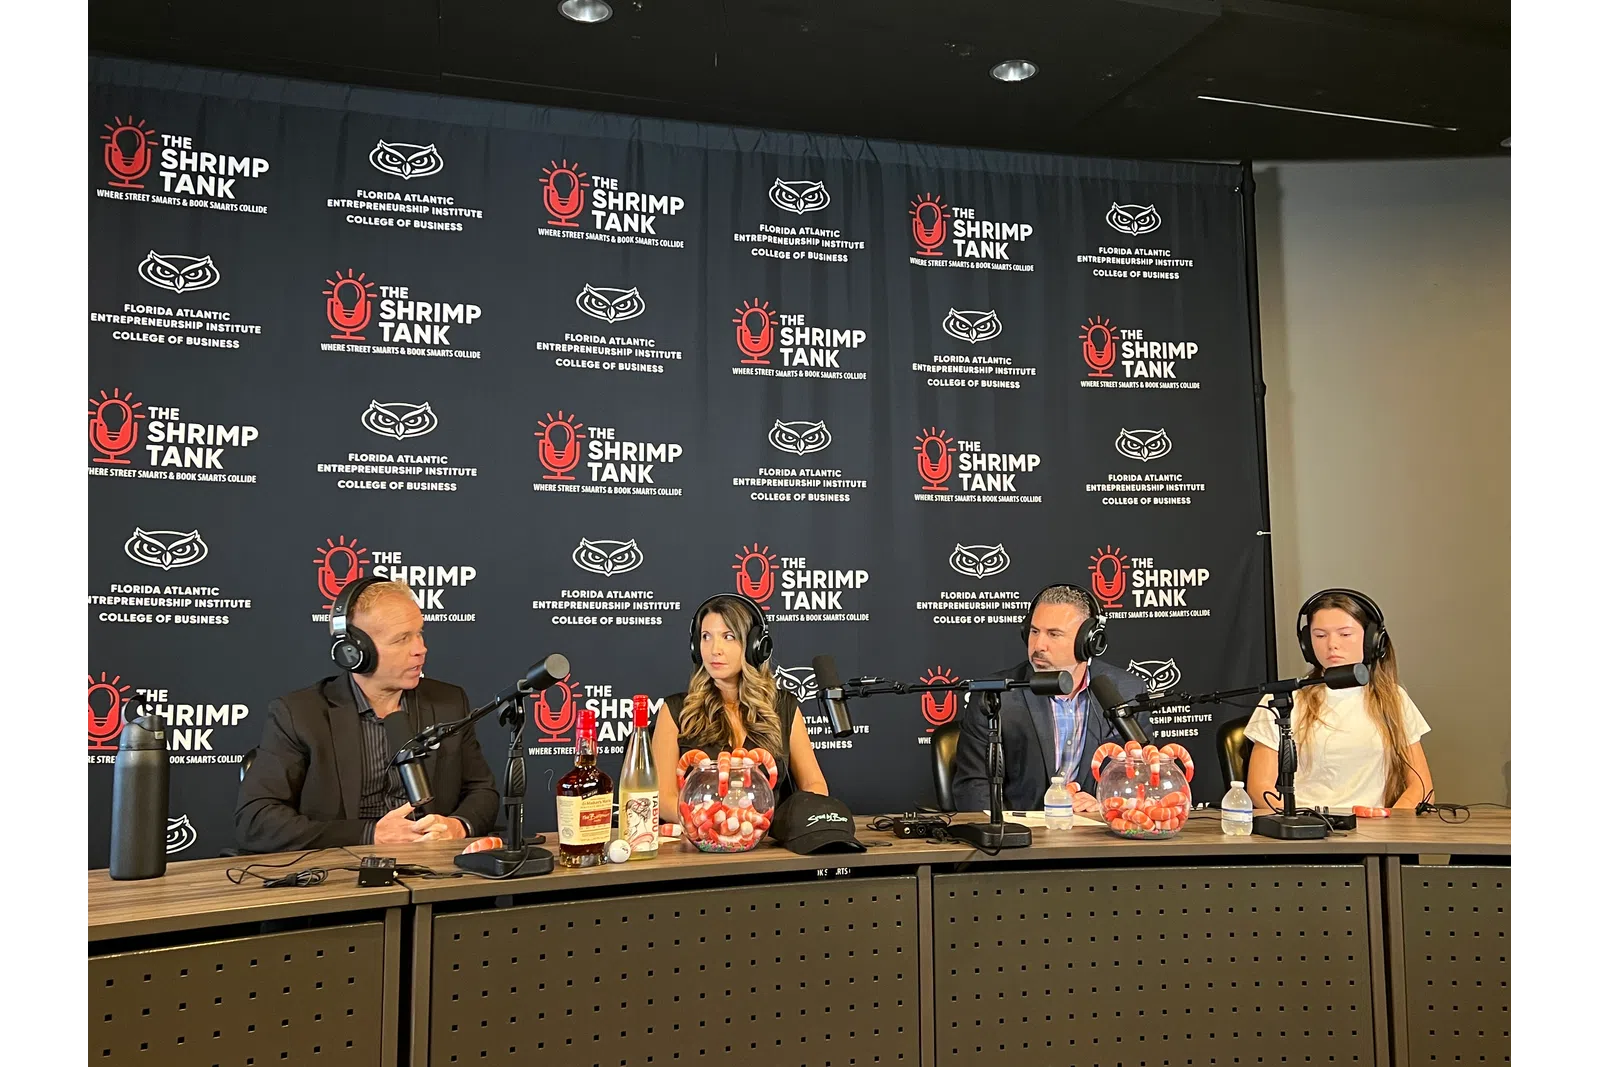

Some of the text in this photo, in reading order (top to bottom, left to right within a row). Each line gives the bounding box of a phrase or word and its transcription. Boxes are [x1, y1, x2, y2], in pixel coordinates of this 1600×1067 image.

[161, 134, 192, 149] THE
[161, 149, 269, 178] SHRIMP
[160, 171, 235, 199] TANK
[592, 176, 618, 190] THE
[97, 189, 123, 200] WHERE
[125, 193, 150, 201] STREET
[152, 195, 180, 205] SMARTS
[189, 200, 208, 208] BOOK
[210, 202, 238, 211] SMARTS
[239, 204, 267, 214] COLLIDE
[357, 190, 454, 205] FLORIDA ATLANTIC
[592, 189, 684, 215] SHRIMP
[328, 199, 482, 218] ENTREPRENEURSHIP INSTITUTE
[952, 208, 974, 220] THE
[346, 215, 462, 231] COLLEGE OF BUSINESS
[592, 210, 656, 234] TANK
[760, 224, 840, 237] FLORIDA ATLANTIC
[954, 219, 1032, 241] SHRIMP
[734, 234, 864, 249] ENTREPRENEURSHIP INSTITUTE
[752, 248, 790, 259] COLLEGE
[808, 252, 848, 262] BUSINESS
[953, 239, 1009, 260] TANK
[1134, 248, 1170, 256] ATLANTIC
[1077, 256, 1153, 265] ENTREPRENEURSHIP
[1093, 269, 1127, 277] COLLEGE
[380, 286, 408, 298] THE
[124, 304, 230, 320] FLORIDA ATLANTIC
[380, 300, 481, 324] SHRIMP
[90, 313, 261, 334] ENTREPRENEURSHIP INSTITUTE
[780, 315, 804, 326] THE
[113, 331, 239, 348] COLLEGE OF BUSINESS
[379, 322, 450, 345] TANK
[565, 334, 655, 347] FLORIDA ATLANTIC
[780, 327, 866, 348] SHRIMP
[1121, 330, 1143, 340] THE
[537, 342, 681, 359] ENTREPRENEURSHIP INSTITUTE
[1122, 341, 1198, 359] SHRIMP
[780, 348, 839, 368] TANK
[972, 356, 1011, 365] ATLANTIC
[556, 358, 600, 368] COLLEGE
[619, 363, 663, 373] BUSINESS
[912, 363, 993, 373] ENTREPRENEURSHIP
[1122, 361, 1176, 378] TANK
[981, 380, 1020, 388] BUSINESS
[148, 407, 179, 420] THE
[148, 421, 258, 446] SHRIMP
[588, 427, 614, 439] THE
[588, 440, 682, 462] SHRIMP
[958, 441, 981, 451] THE
[146, 445, 224, 469] TANK
[349, 454, 448, 464] FLORIDA ATLANTIC
[959, 453, 1040, 472] SHRIMP
[88, 467, 108, 476] HERE
[110, 469, 136, 477] STREET
[138, 470, 167, 479] SMARTS
[198, 474, 226, 482] SMARTS
[318, 464, 477, 476] ENTREPRENEURSHIP INSTITUTE
[588, 462, 654, 483] TANK
[799, 469, 841, 477] ATLANTIC
[338, 480, 386, 489] COLLEGE
[407, 482, 456, 491] BUSINESS
[733, 478, 821, 486] ENTREPRENEURSHIP
[959, 473, 1016, 491] TANK
[751, 492, 791, 500] COLLEGE
[372, 552, 401, 564] THE
[781, 558, 806, 568] THE
[1132, 558, 1153, 568] THE
[373, 566, 476, 586] SHRIMP
[782, 570, 868, 589] SHRIMP
[1132, 569, 1209, 588] SHRIMP
[111, 584, 219, 596] FLORIDA ATLANTIC
[562, 590, 604, 598] FLORIDA
[88, 596, 251, 608] NTREPRENEURSHIP INSTITUTE
[410, 589, 444, 609] NK
[533, 601, 630, 609] ENTREPRENEURSHIP
[781, 591, 842, 610] TANK
[1132, 589, 1186, 607] TANK
[99, 613, 229, 624] COLLEGE OF BUSINESS
[552, 616, 597, 624] COLLEGE
[136, 689, 168, 702] THE
[585, 685, 612, 697] THE
[1152, 705, 1190, 714] LANTIC
[1174, 714, 1212, 723] INSTITUTE
[1161, 729, 1198, 737] BUSINESS
[811, 740, 852, 749] BUSINESS
[186, 755, 244, 764] SMARTS COLLID
